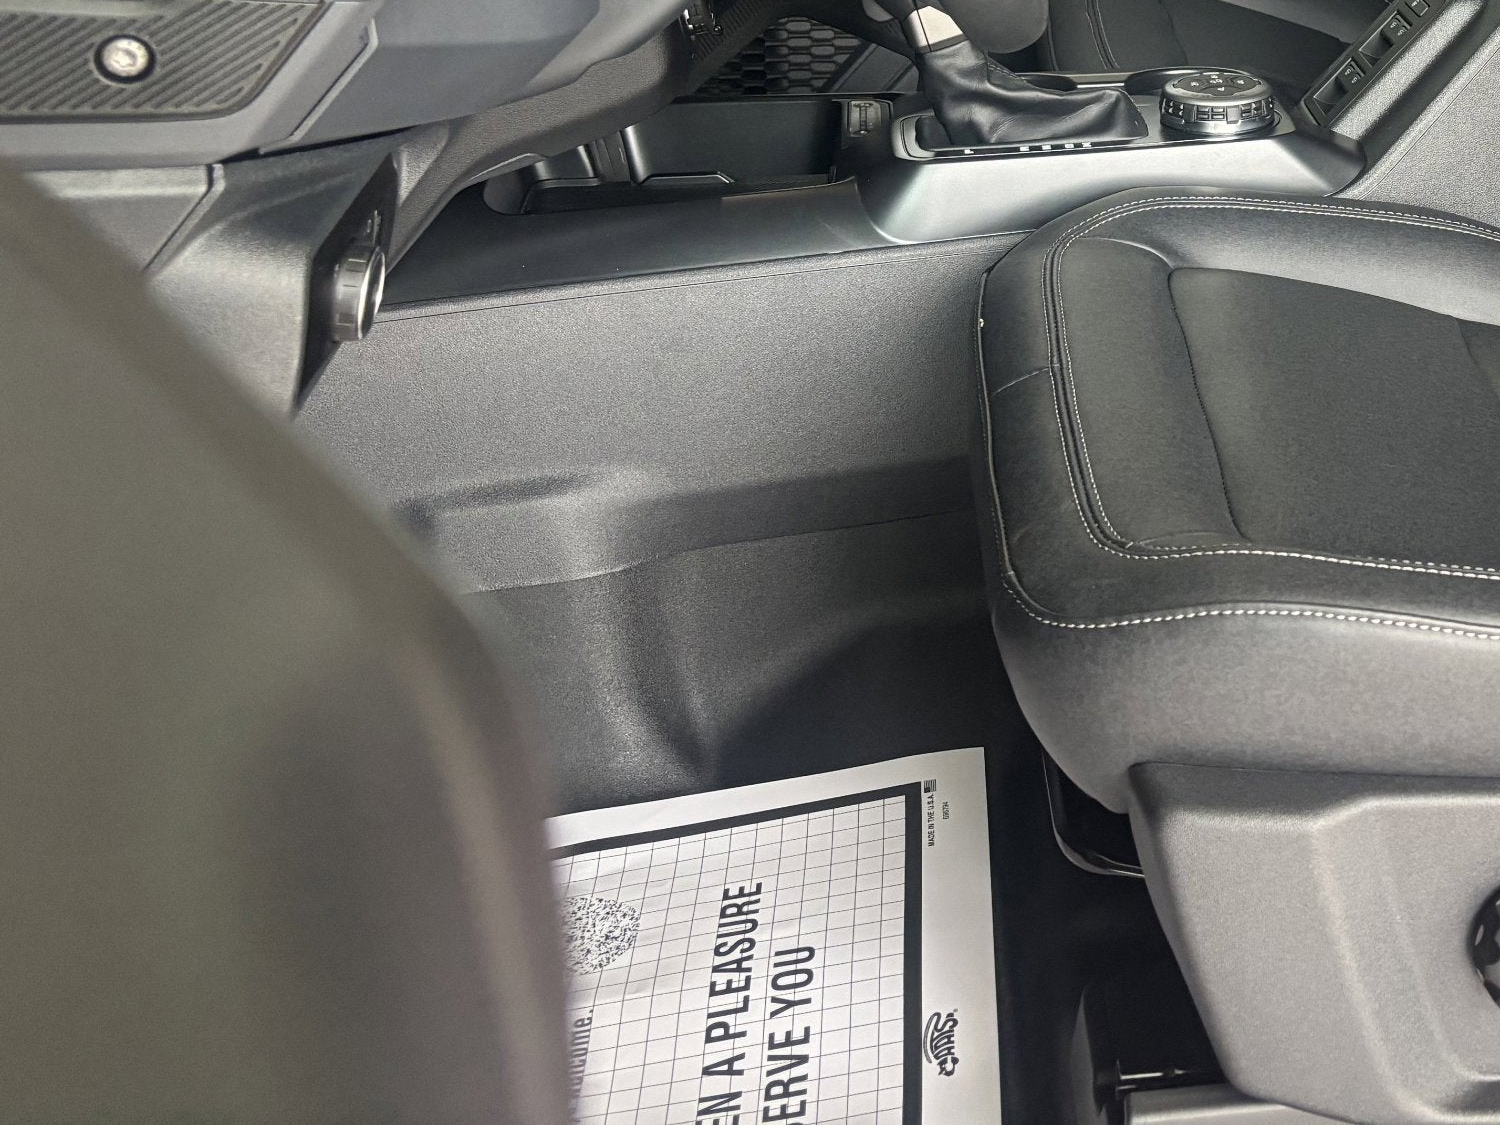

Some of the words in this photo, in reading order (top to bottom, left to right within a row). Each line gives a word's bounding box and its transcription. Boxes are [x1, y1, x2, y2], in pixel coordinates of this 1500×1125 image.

[927, 811, 935, 823] THE
[705, 882, 762, 1044] PLEASURE
[770, 947, 816, 1019] YOU
[702, 1052, 745, 1075] A
[762, 1026, 811, 1125] ERVE
